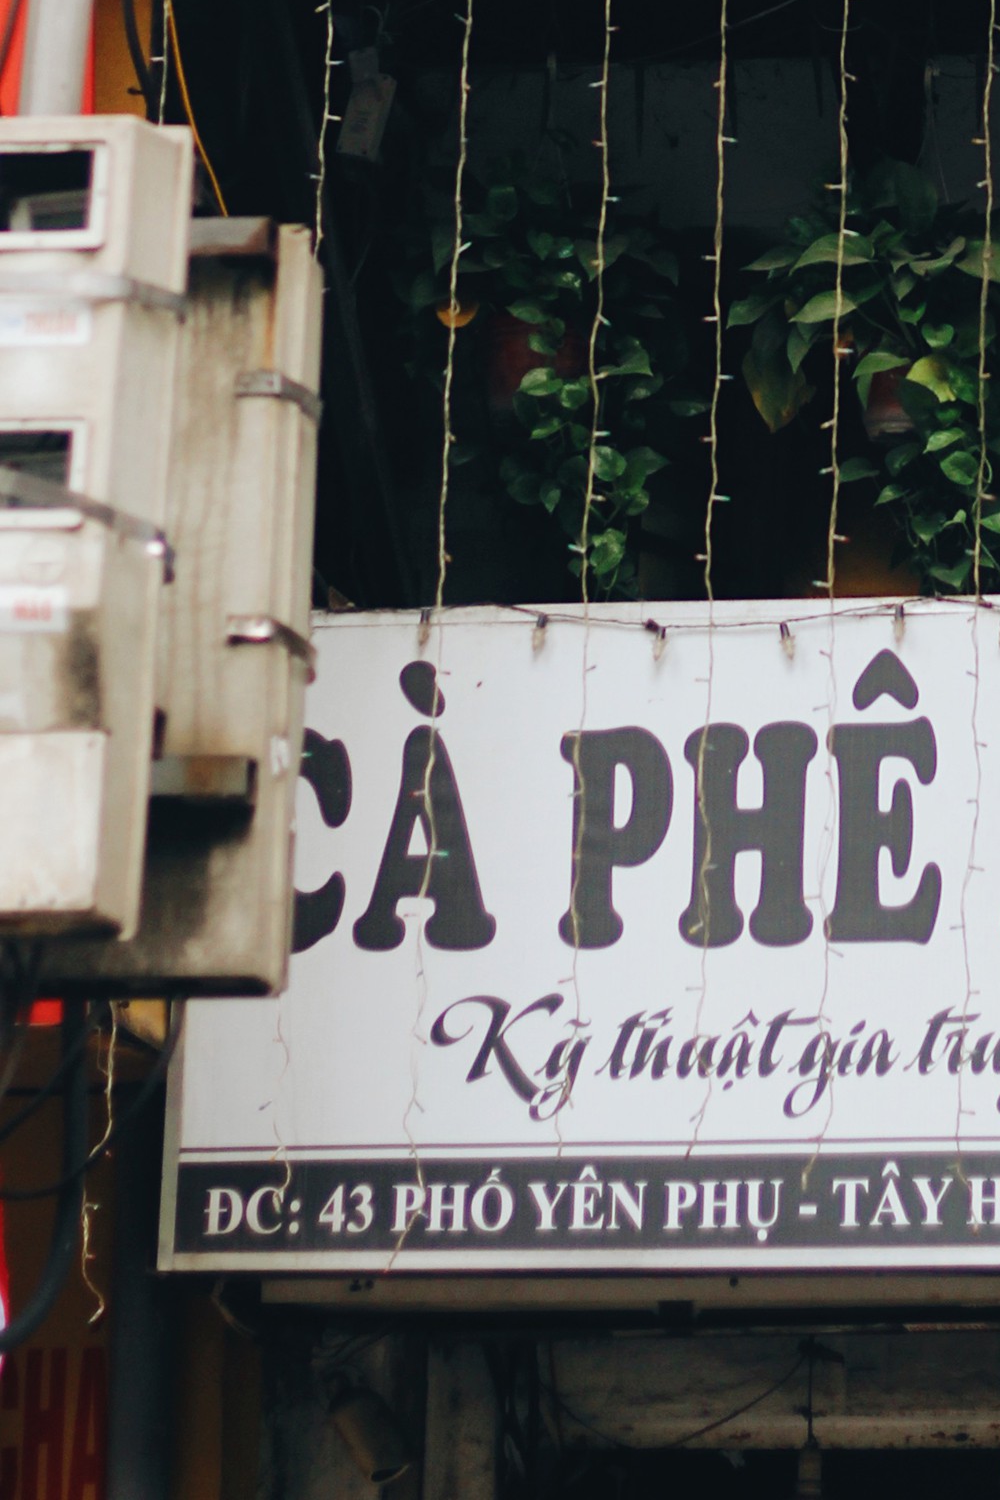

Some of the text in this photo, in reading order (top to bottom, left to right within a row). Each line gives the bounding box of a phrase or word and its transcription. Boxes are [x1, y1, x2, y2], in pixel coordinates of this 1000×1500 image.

[558, 648, 943, 950] PHÊ
[430, 992, 592, 1122] Kỹ
[594, 1006, 820, 1091] thuật
[783, 1020, 900, 1119] gia
[203, 1185, 301, 1235] ĐC:
[318, 1183, 374, 1233] 43
[390, 1168, 514, 1233] PHỐ
[528, 1165, 649, 1231] YÊN
[663, 1179, 784, 1242] PHỤ
[832, 1161, 955, 1228] TÂY
